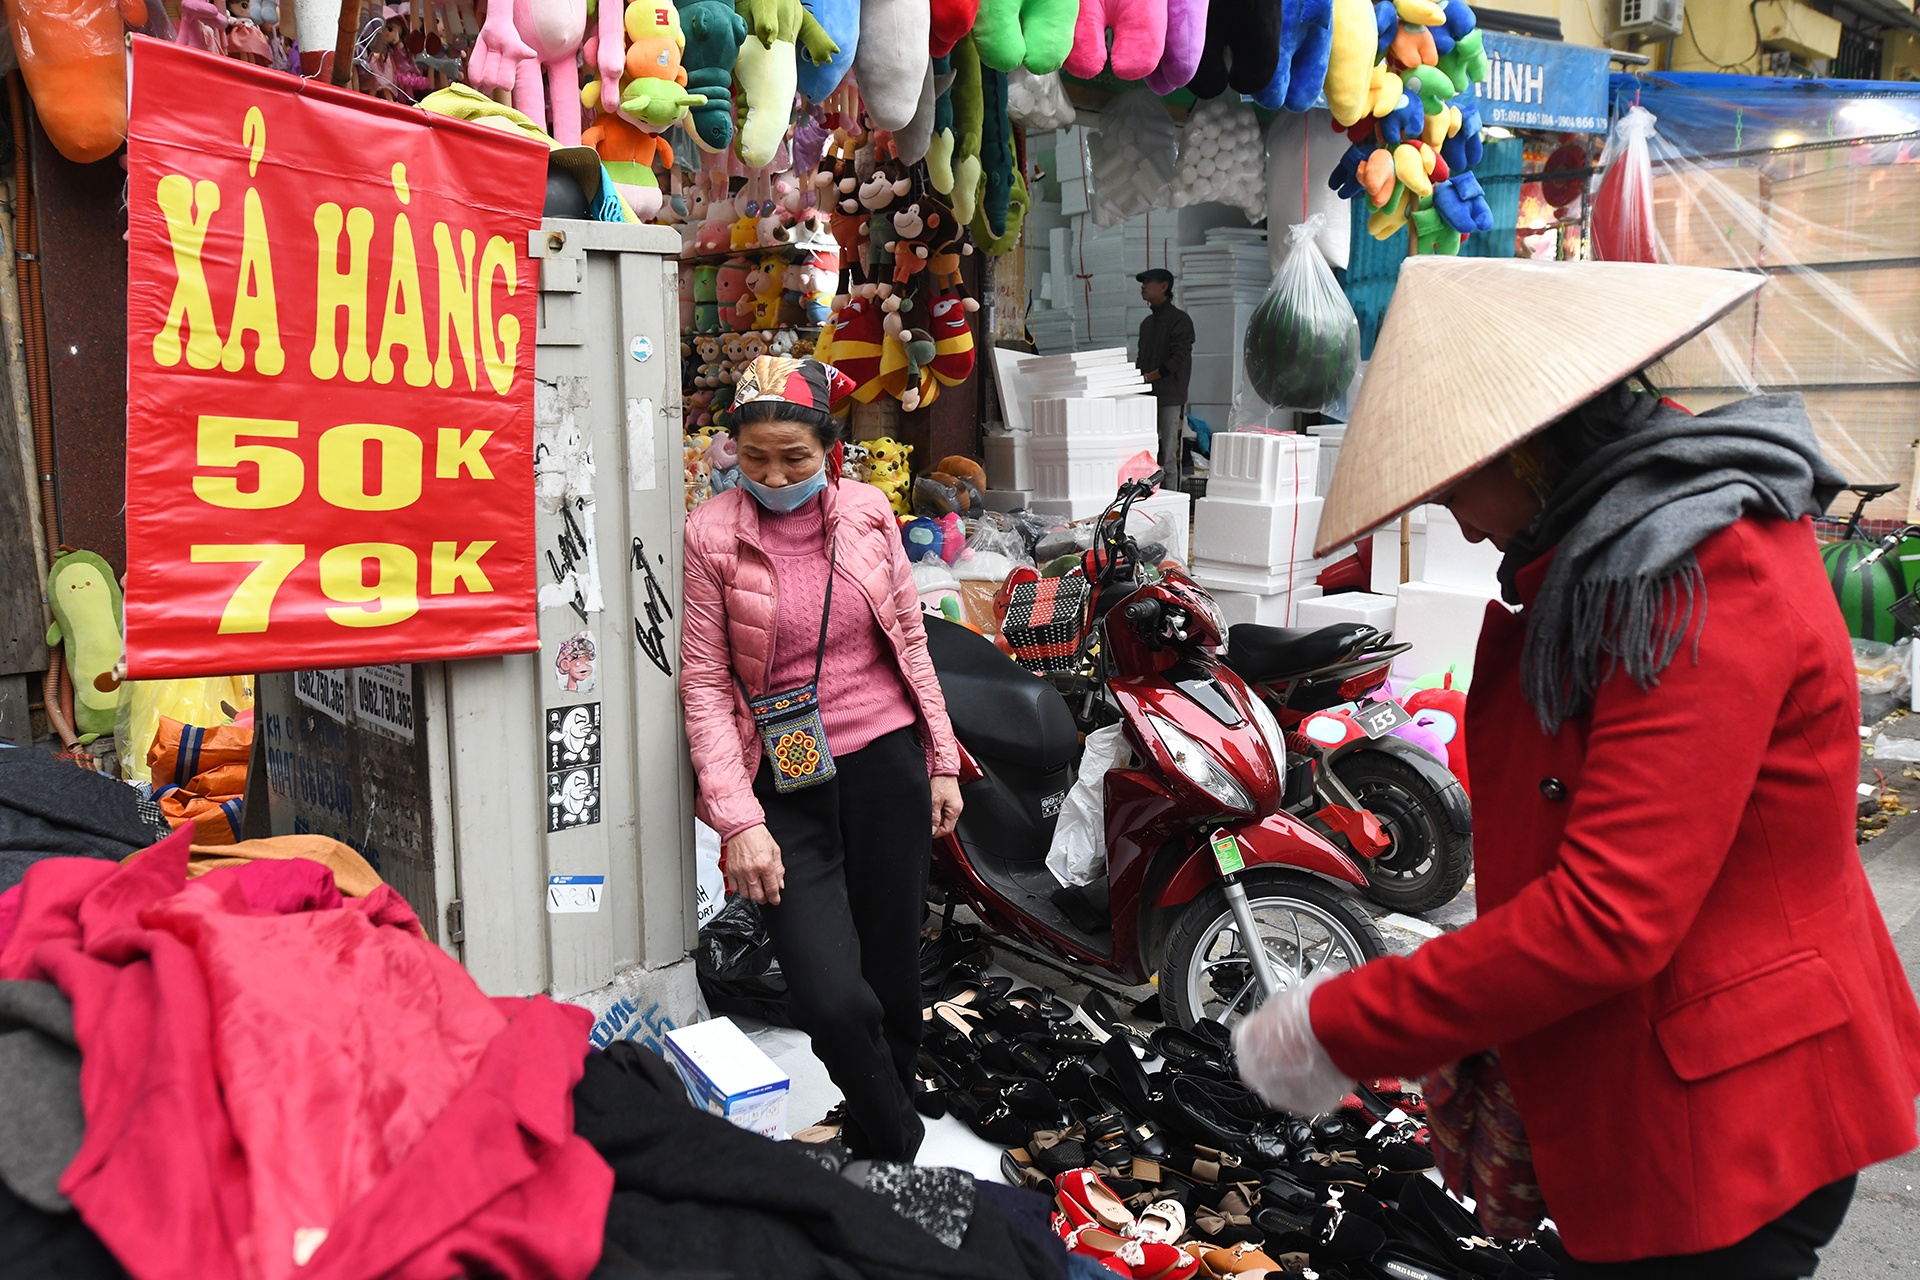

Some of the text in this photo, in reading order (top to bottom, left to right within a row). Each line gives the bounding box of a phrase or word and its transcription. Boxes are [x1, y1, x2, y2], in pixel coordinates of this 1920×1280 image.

[1575, 115, 1595, 129] 866
[152, 106, 521, 395] XẢ HÀNG
[358, 676, 413, 730] 0962.750.365
[1369, 707, 1397, 733] 133
